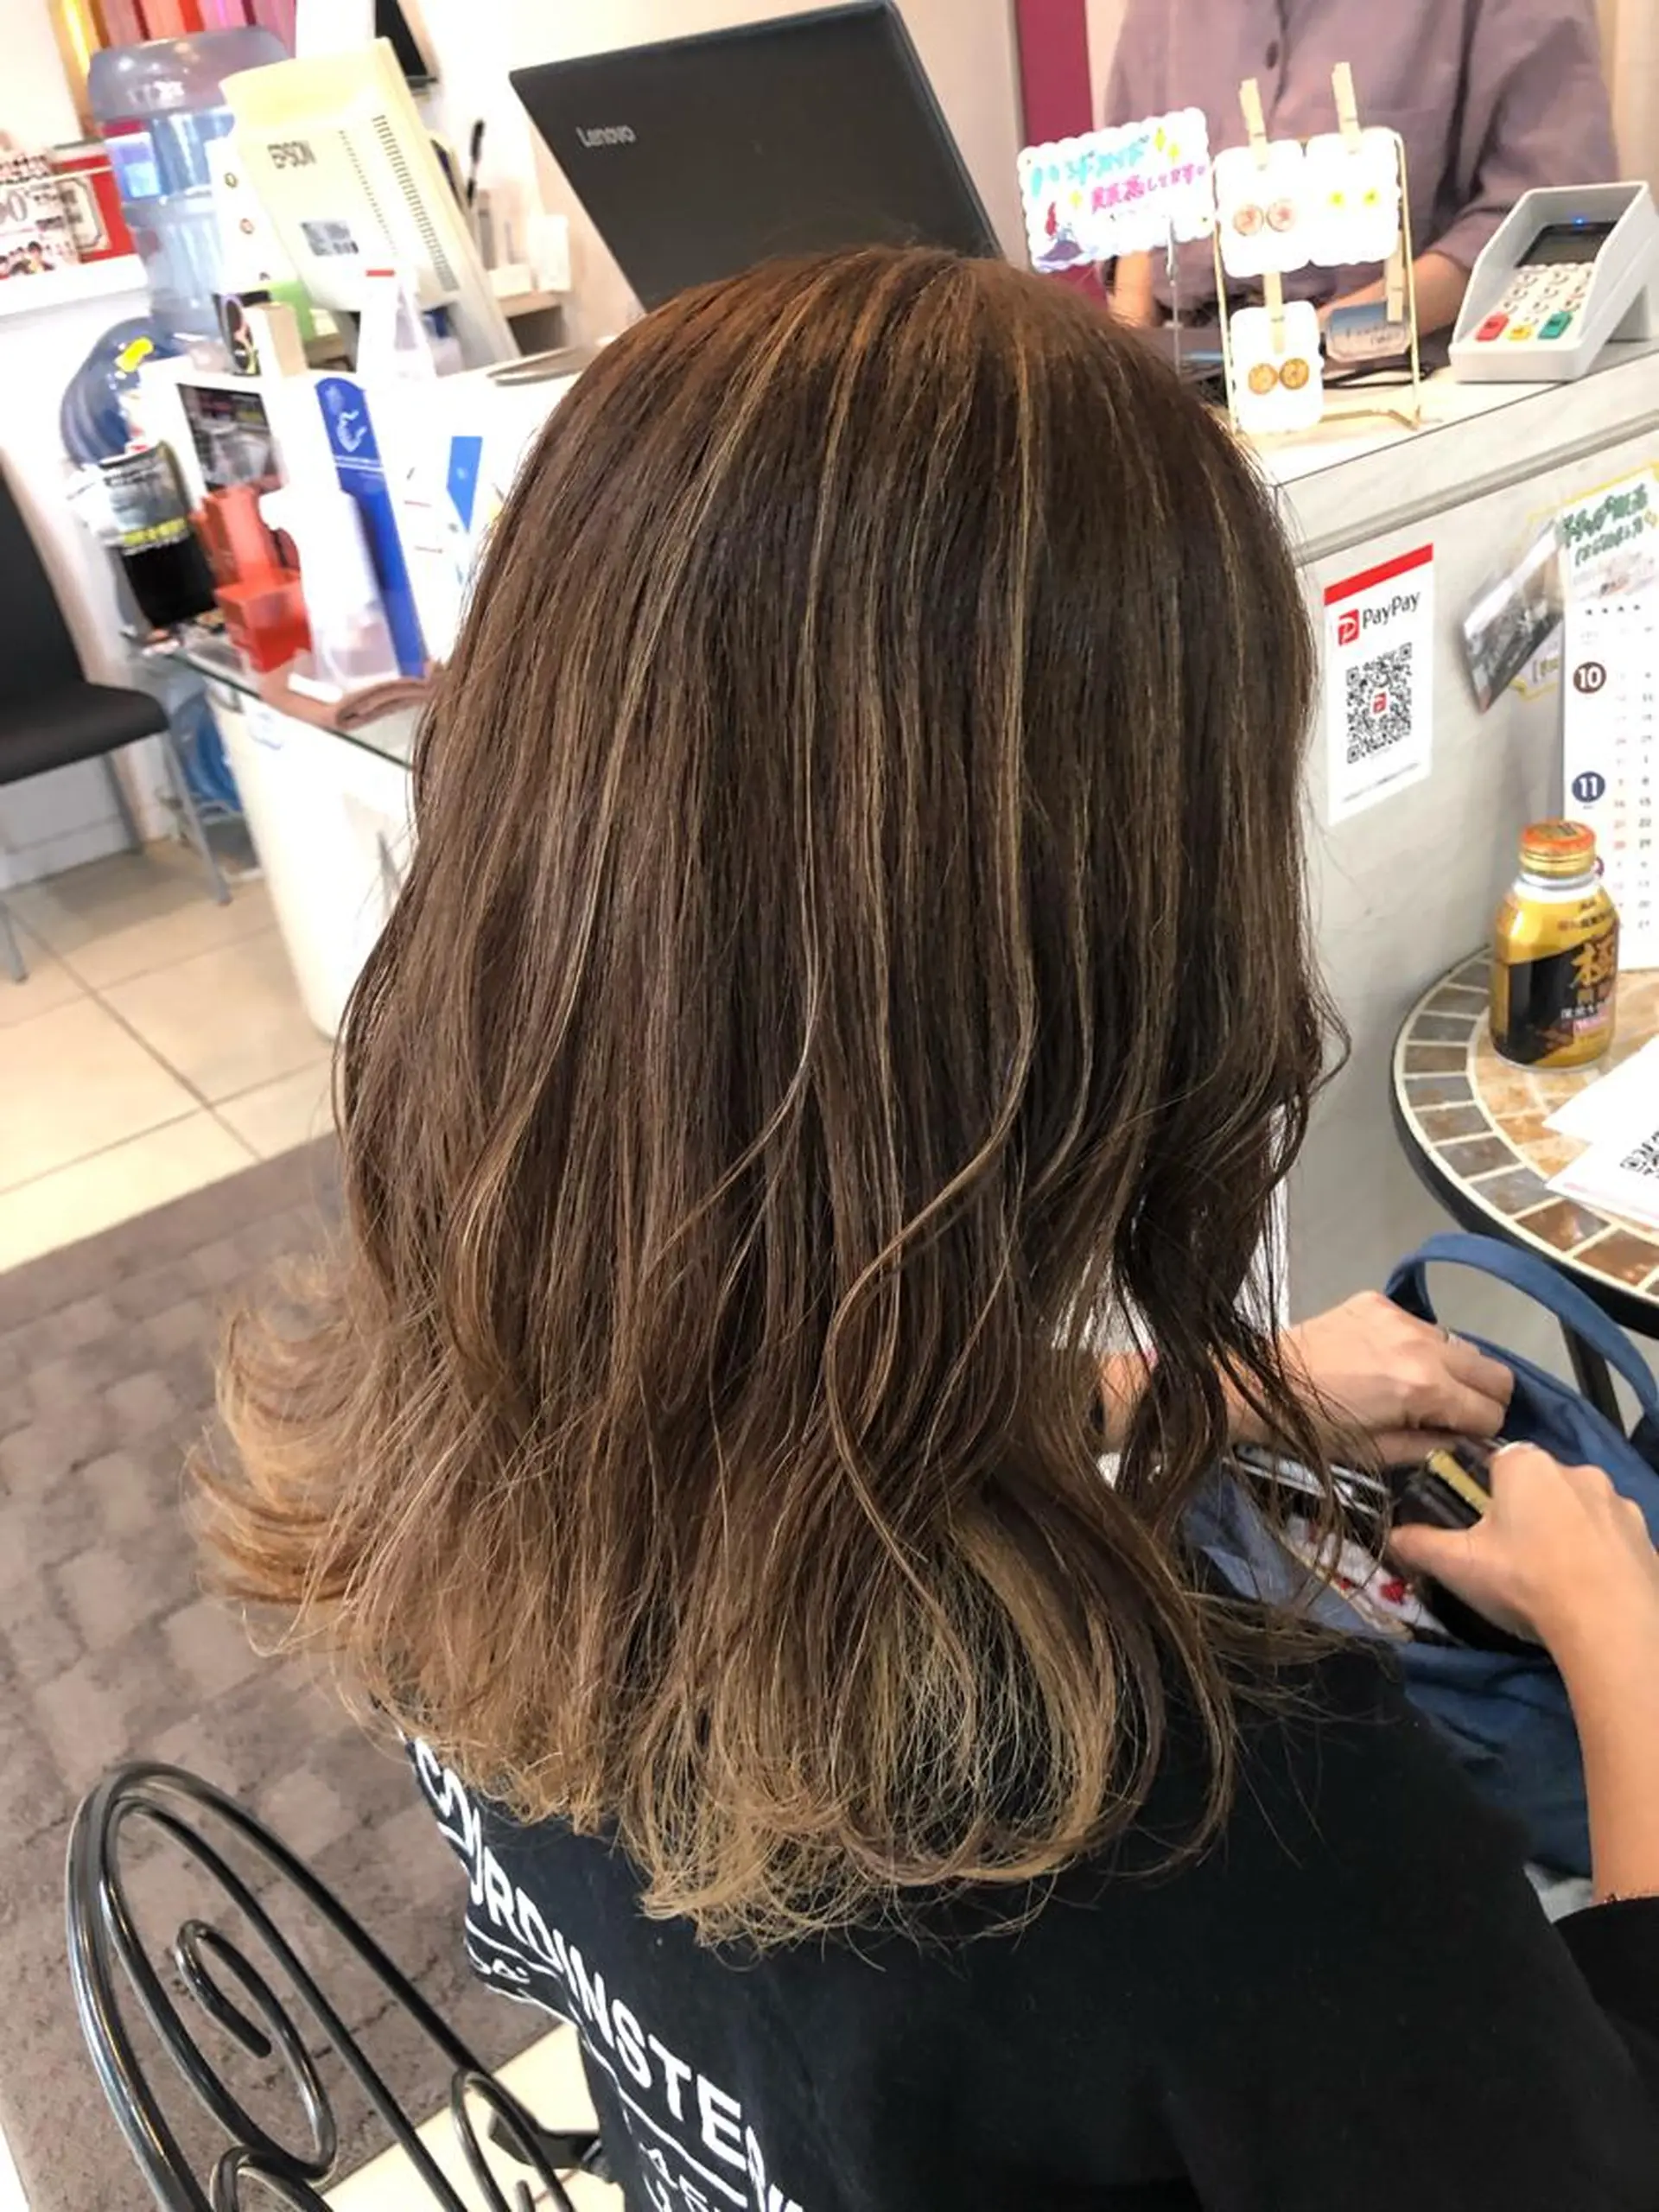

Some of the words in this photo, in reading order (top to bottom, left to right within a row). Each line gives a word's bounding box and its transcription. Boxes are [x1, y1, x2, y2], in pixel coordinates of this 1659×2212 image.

[575, 124, 636, 148] Lenovo
[267, 140, 316, 168] EPSON
[1363, 592, 1421, 630] PayPay
[1579, 666, 1602, 690] 10
[1580, 775, 1598, 797] 11
